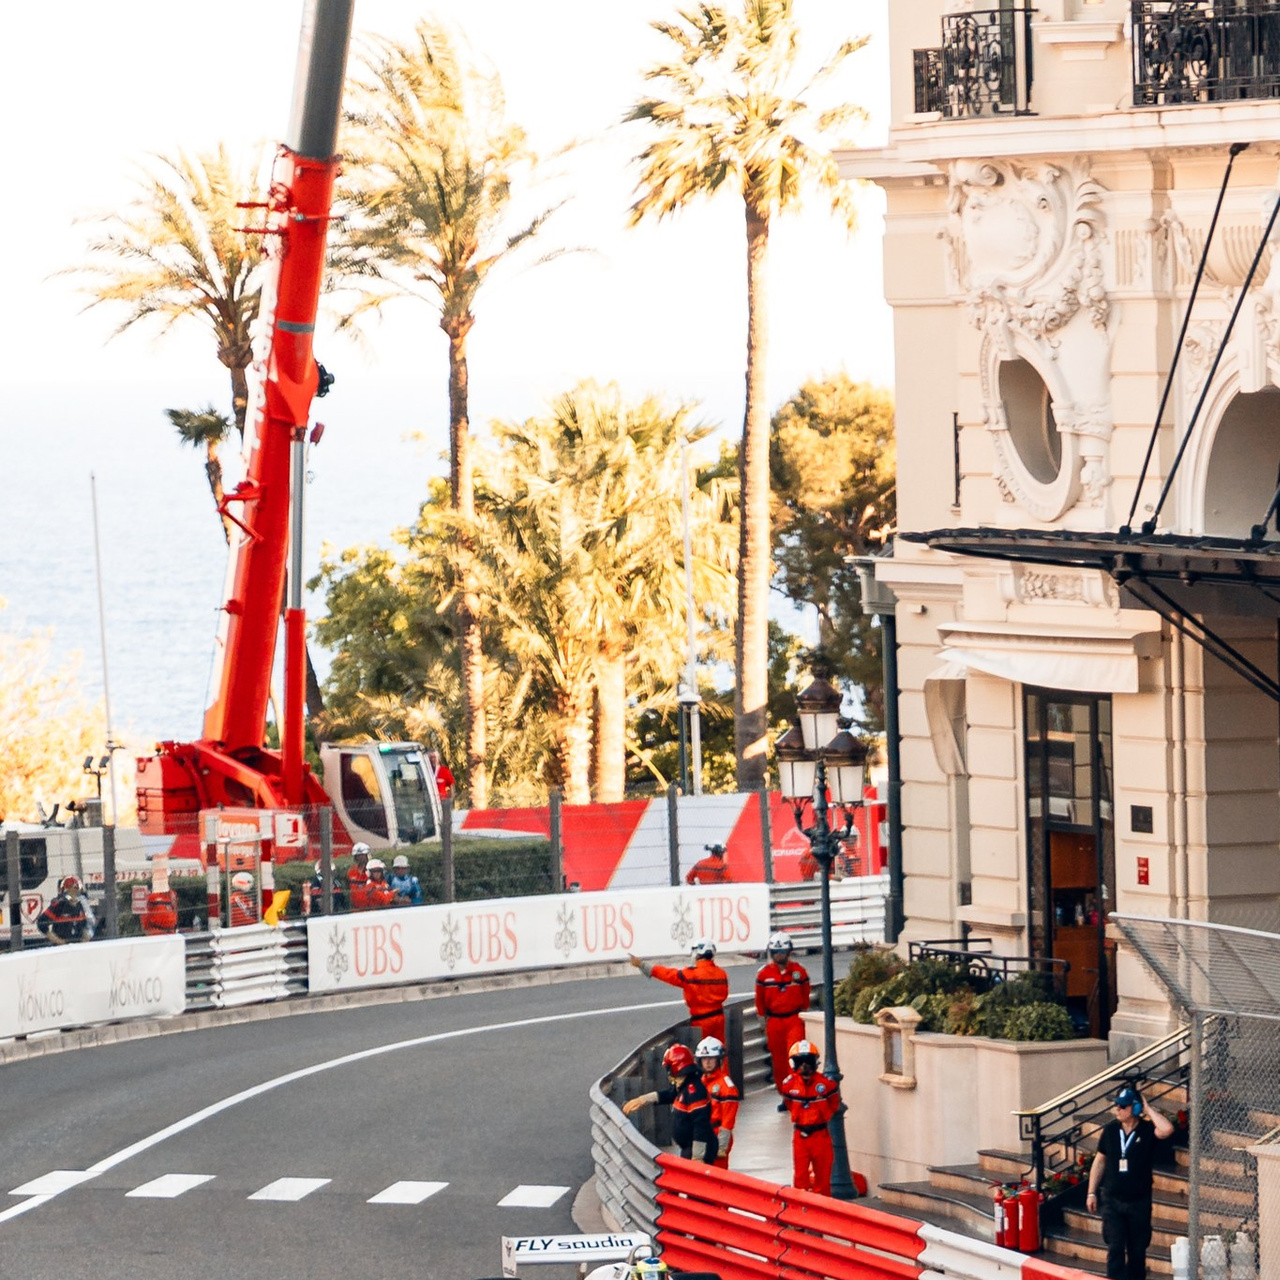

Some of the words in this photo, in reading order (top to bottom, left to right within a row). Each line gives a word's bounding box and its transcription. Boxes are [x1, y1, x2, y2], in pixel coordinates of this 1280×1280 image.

[466, 912, 518, 965] UBS
[581, 902, 634, 954] UBS
[697, 897, 751, 943] UBS
[352, 923, 403, 978] UBS
[18, 990, 64, 1023] MONACO
[109, 977, 162, 1010] MONACO
[516, 1238, 554, 1252] FLY
[558, 1235, 633, 1250] saudia
